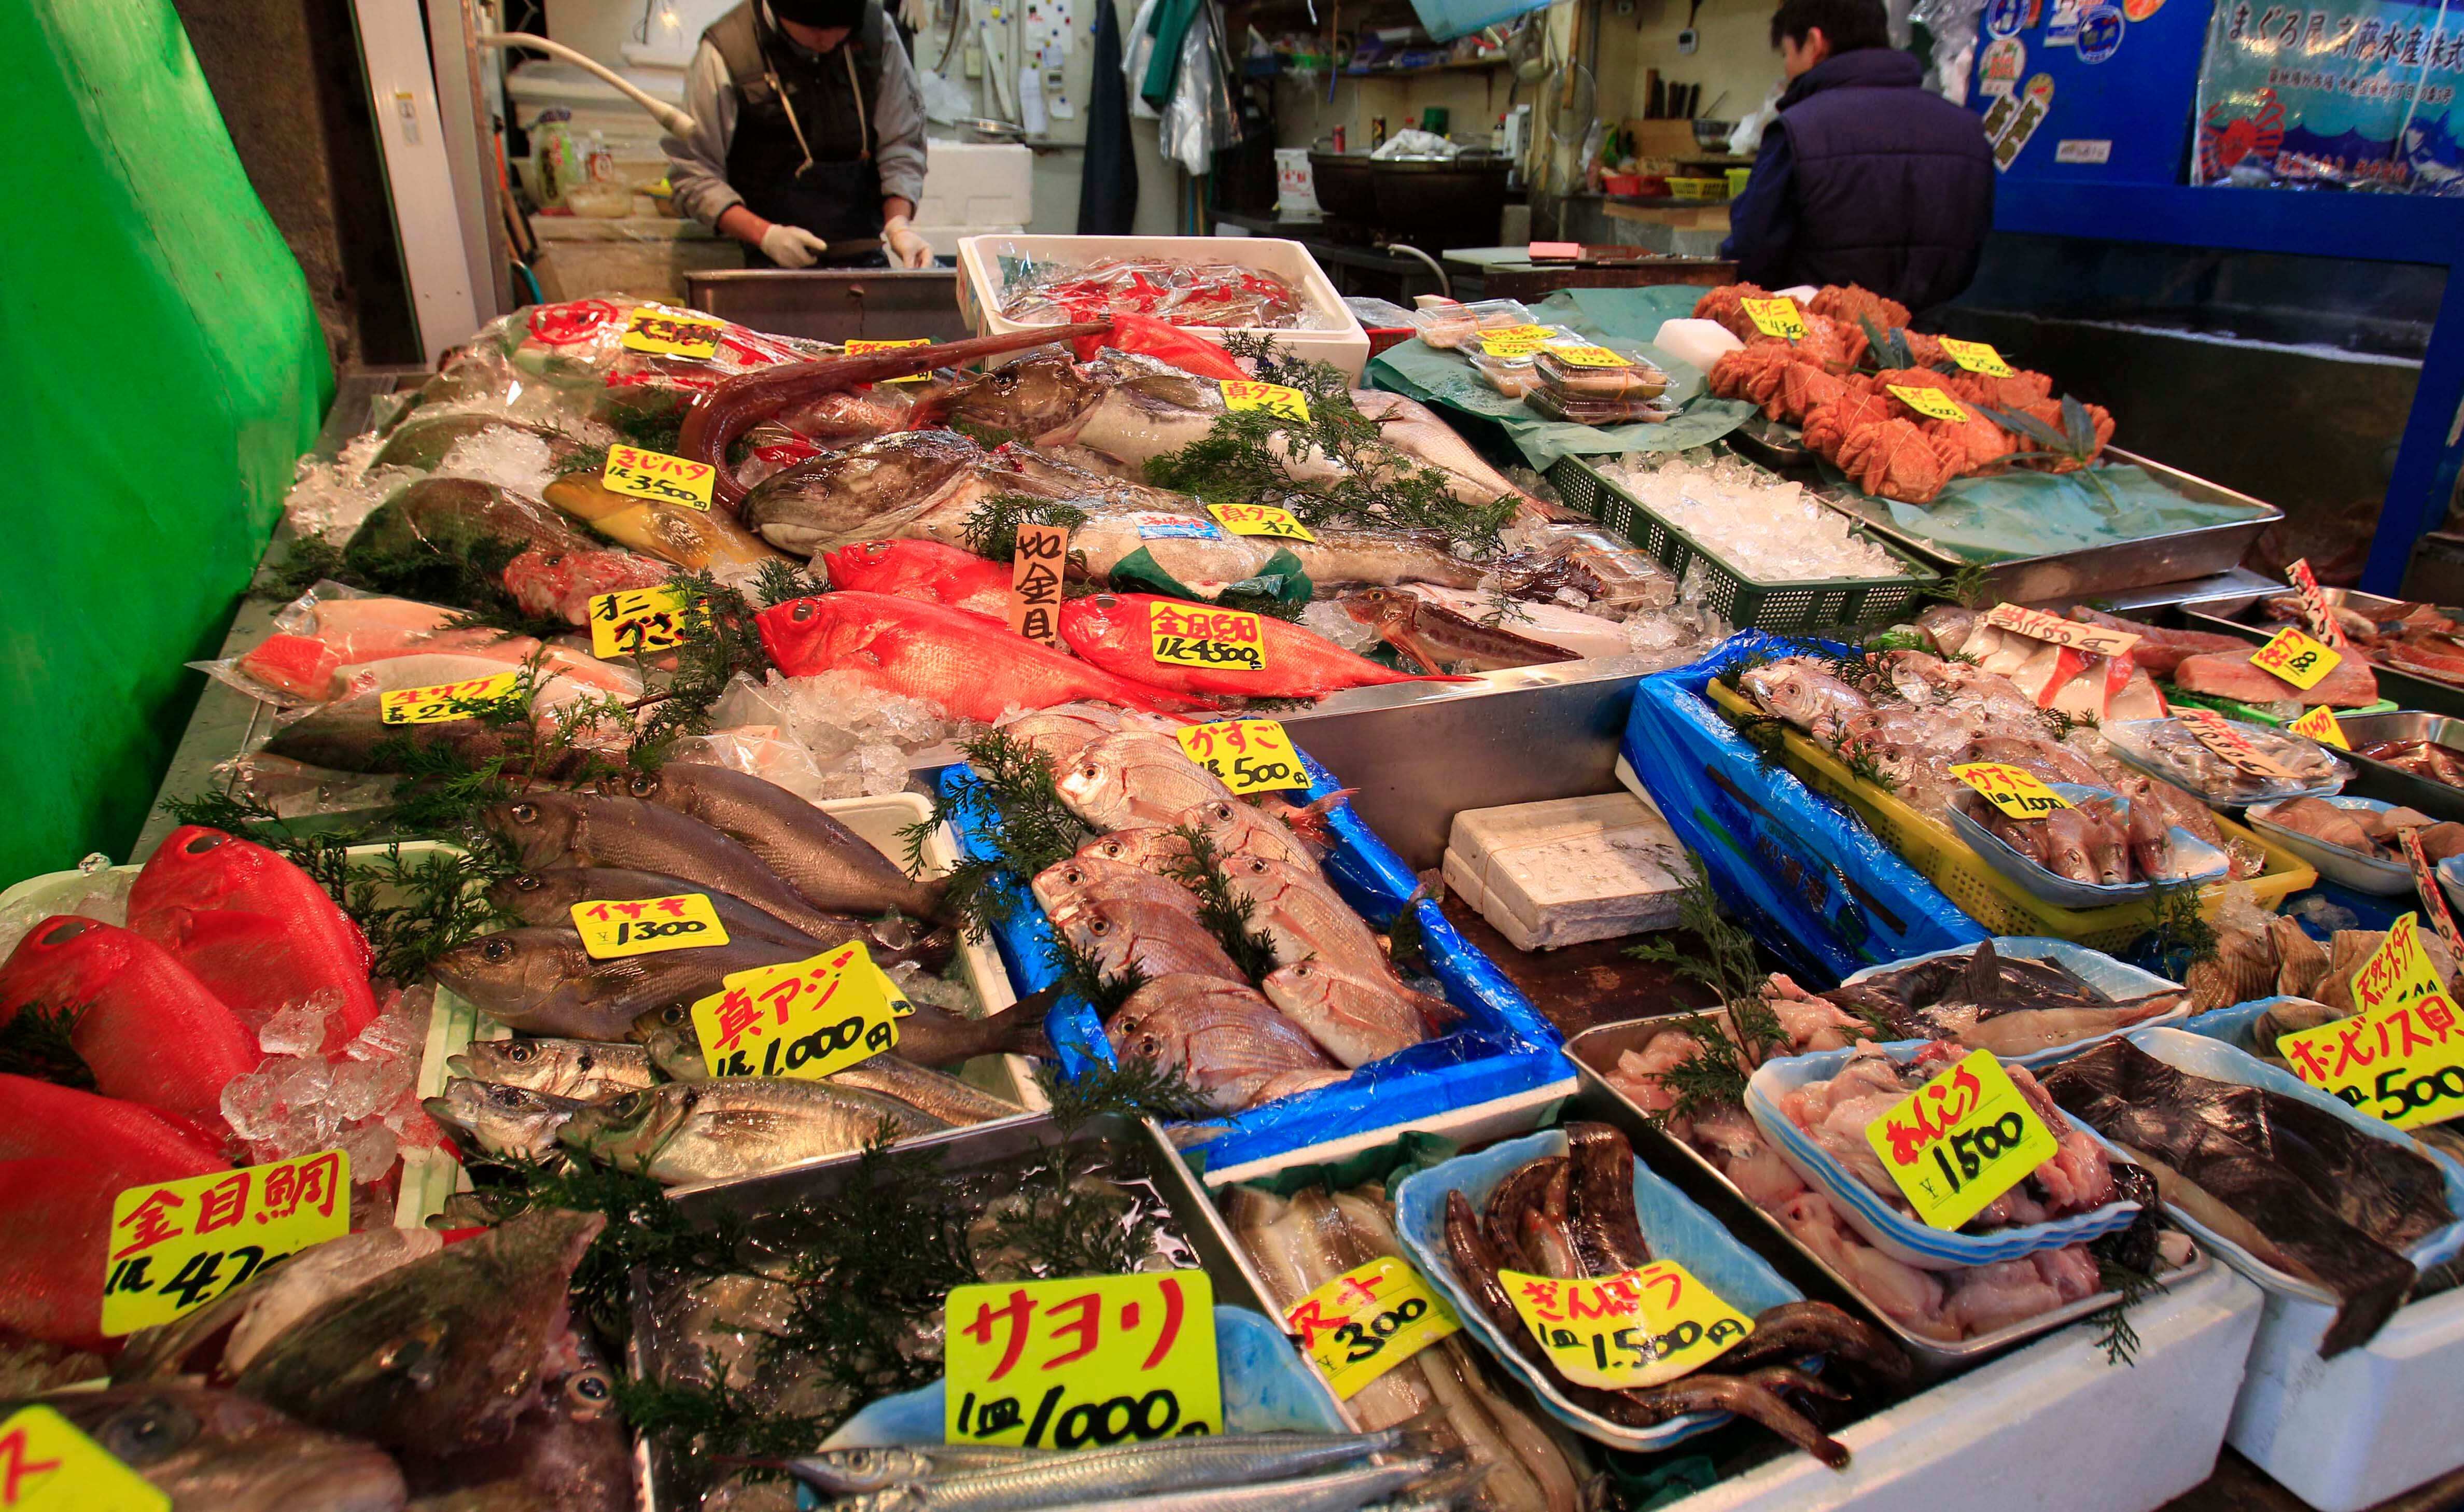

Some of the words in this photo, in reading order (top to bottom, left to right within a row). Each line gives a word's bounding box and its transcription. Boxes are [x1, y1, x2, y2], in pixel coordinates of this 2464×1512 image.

[1225, 381, 1292, 402] 真タラ
[1256, 401, 1295, 414] メス
[615, 448, 710, 481] きじハタ
[1219, 503, 1287, 527] 真タラ
[1263, 520, 1305, 538] オス
[1015, 531, 1062, 648] 地金目
[592, 594, 650, 621] オニ
[1151, 607, 1258, 643] 金目鯛
[1186, 720, 1279, 758] かすご
[1965, 766, 2037, 790] かすご
[586, 897, 688, 922] イサキ
[712, 949, 855, 1052] 真アジ
[2290, 995, 2464, 1083] ホンビノス貝
[113, 1152, 340, 1260] 金目鯛
[962, 1278, 1184, 1382] サヨリ
